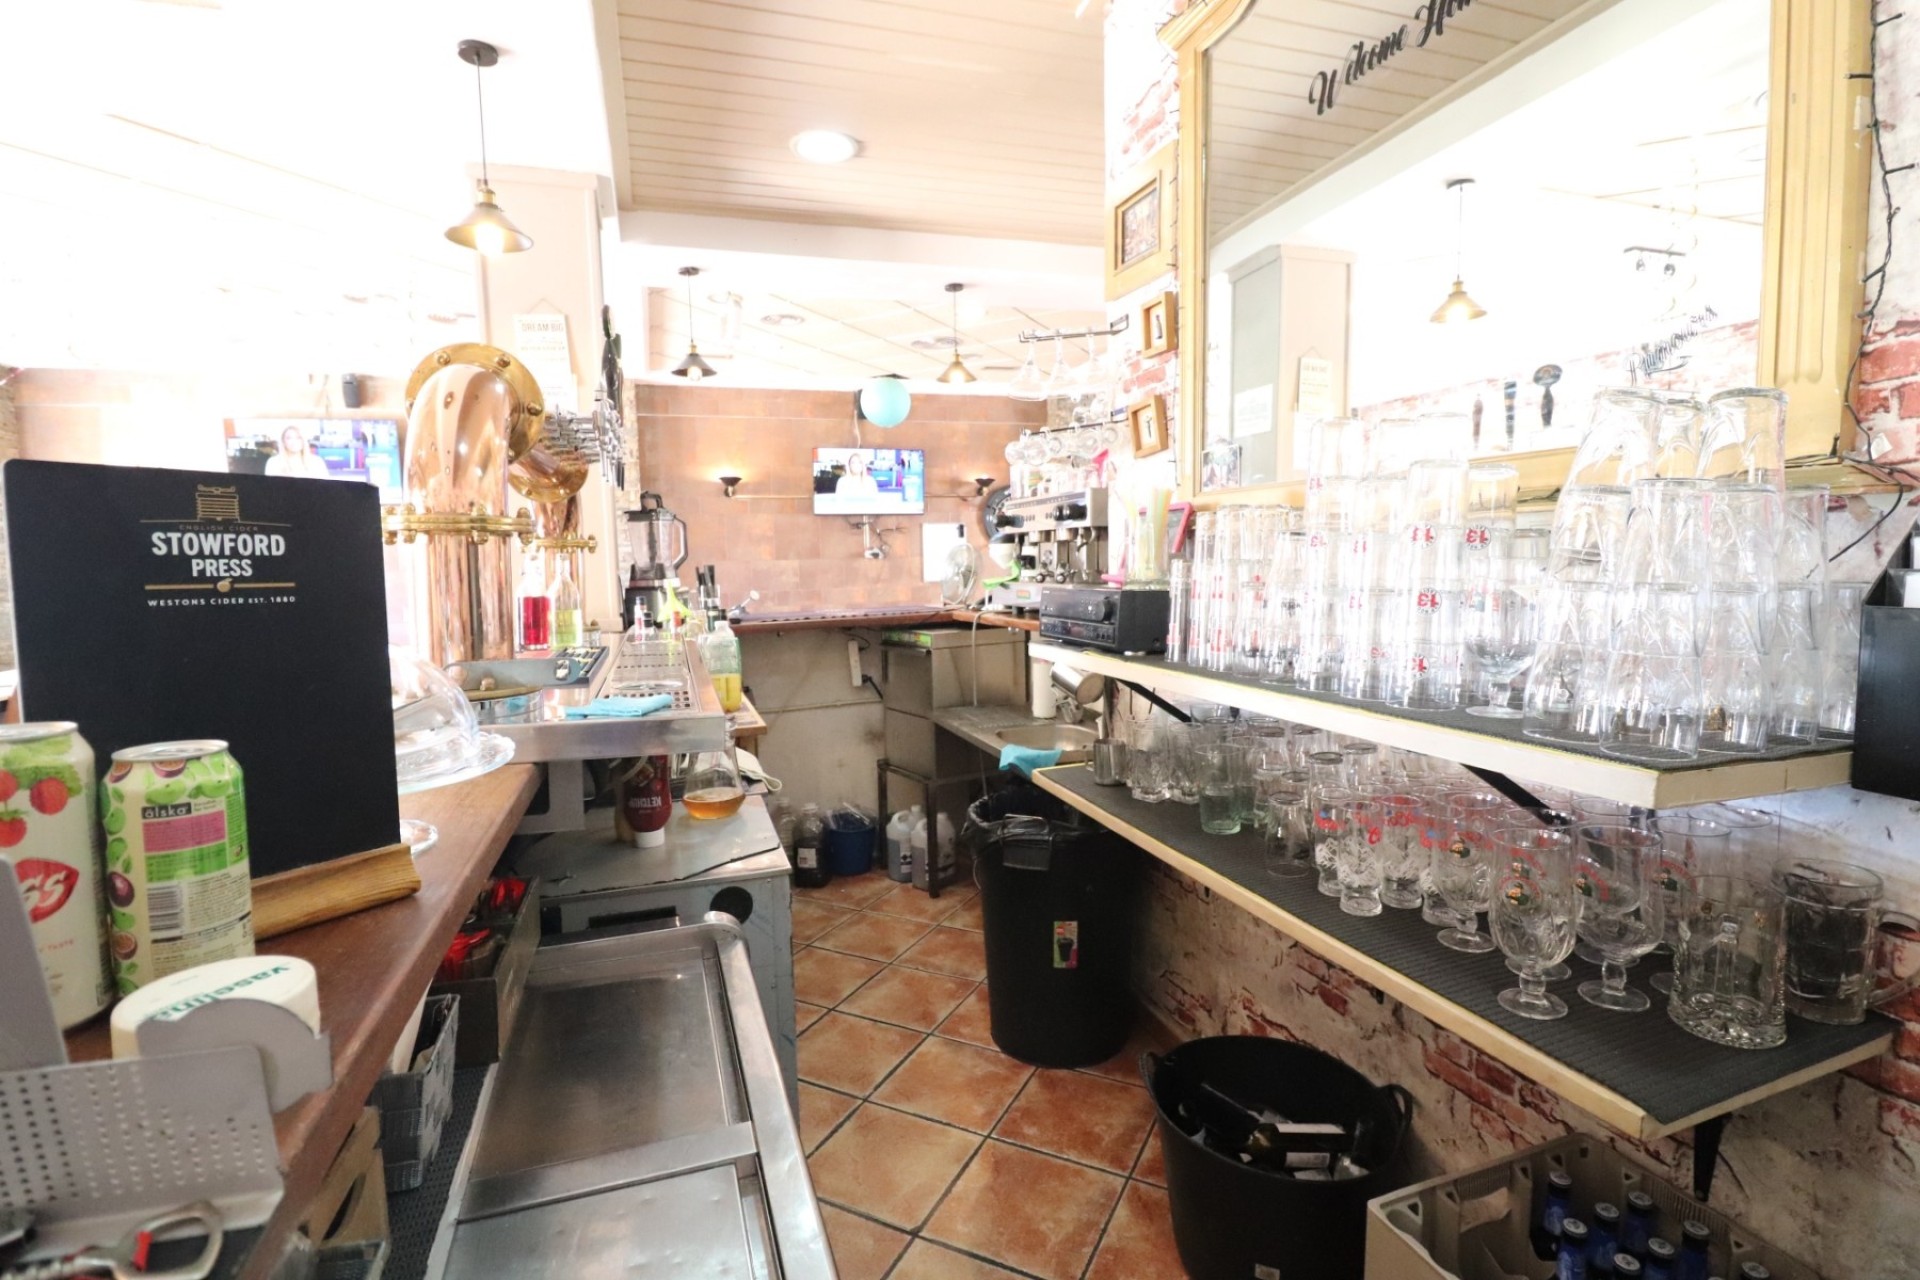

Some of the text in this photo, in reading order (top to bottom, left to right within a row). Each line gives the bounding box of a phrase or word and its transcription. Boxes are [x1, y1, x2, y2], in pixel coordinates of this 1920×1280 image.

[151, 532, 286, 556] STOWFORD
[191, 558, 253, 577] PRESS
[147, 597, 206, 607] WESTONS
[210, 597, 244, 605] CIDER
